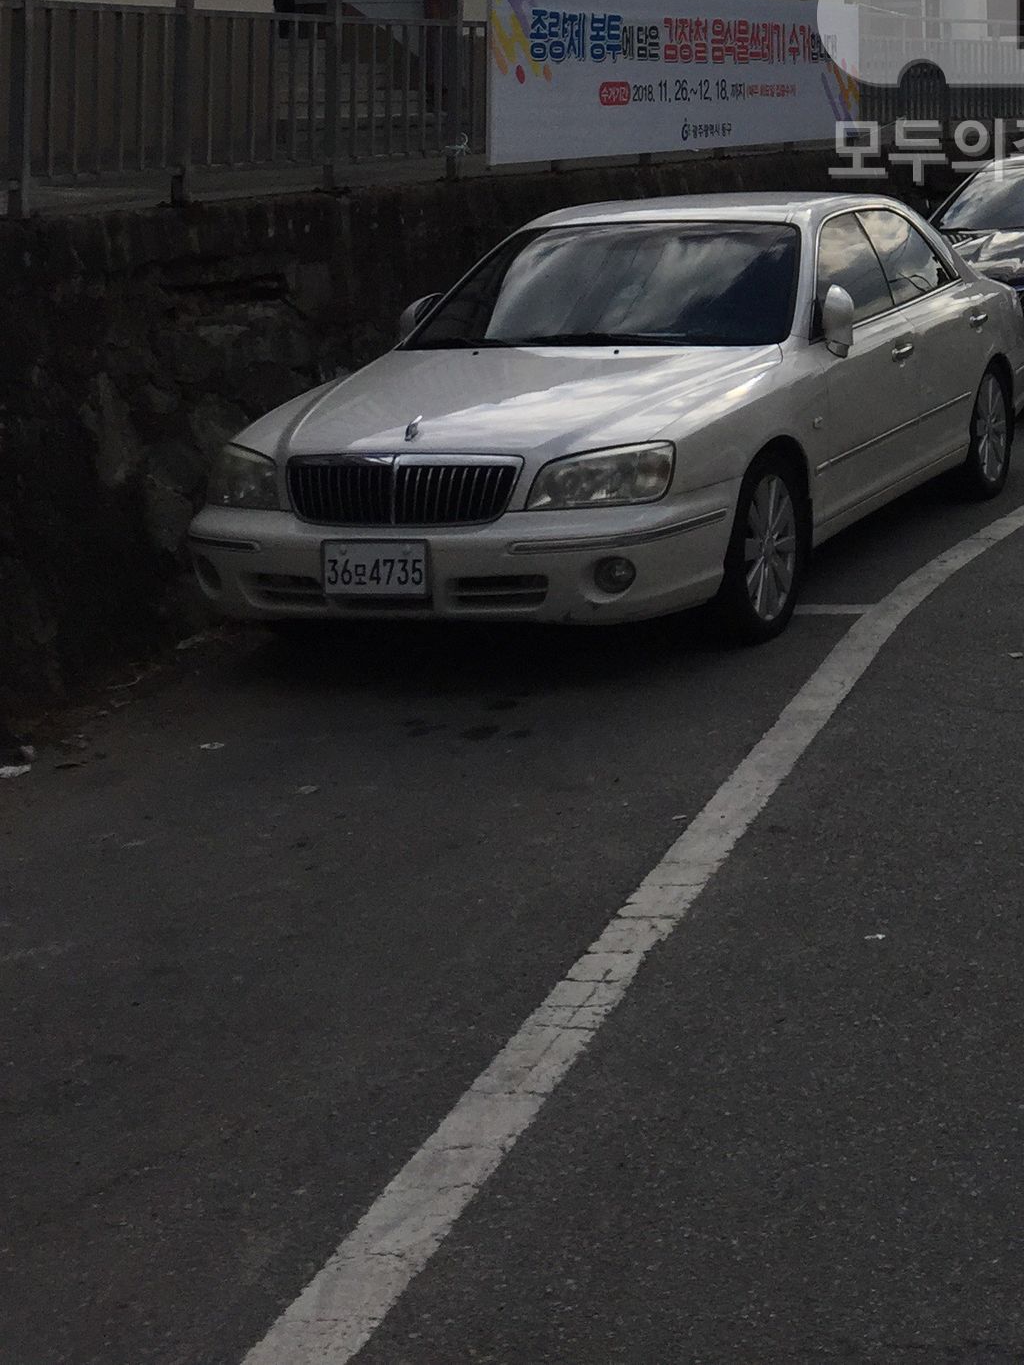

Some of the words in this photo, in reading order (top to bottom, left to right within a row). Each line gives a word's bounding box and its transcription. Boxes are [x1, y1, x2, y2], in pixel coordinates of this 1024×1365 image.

[529, 8, 586, 62] 종량제
[635, 24, 660, 62] 담은
[663, 16, 709, 64] 김장철
[326, 557, 424, 586] 36모4735
